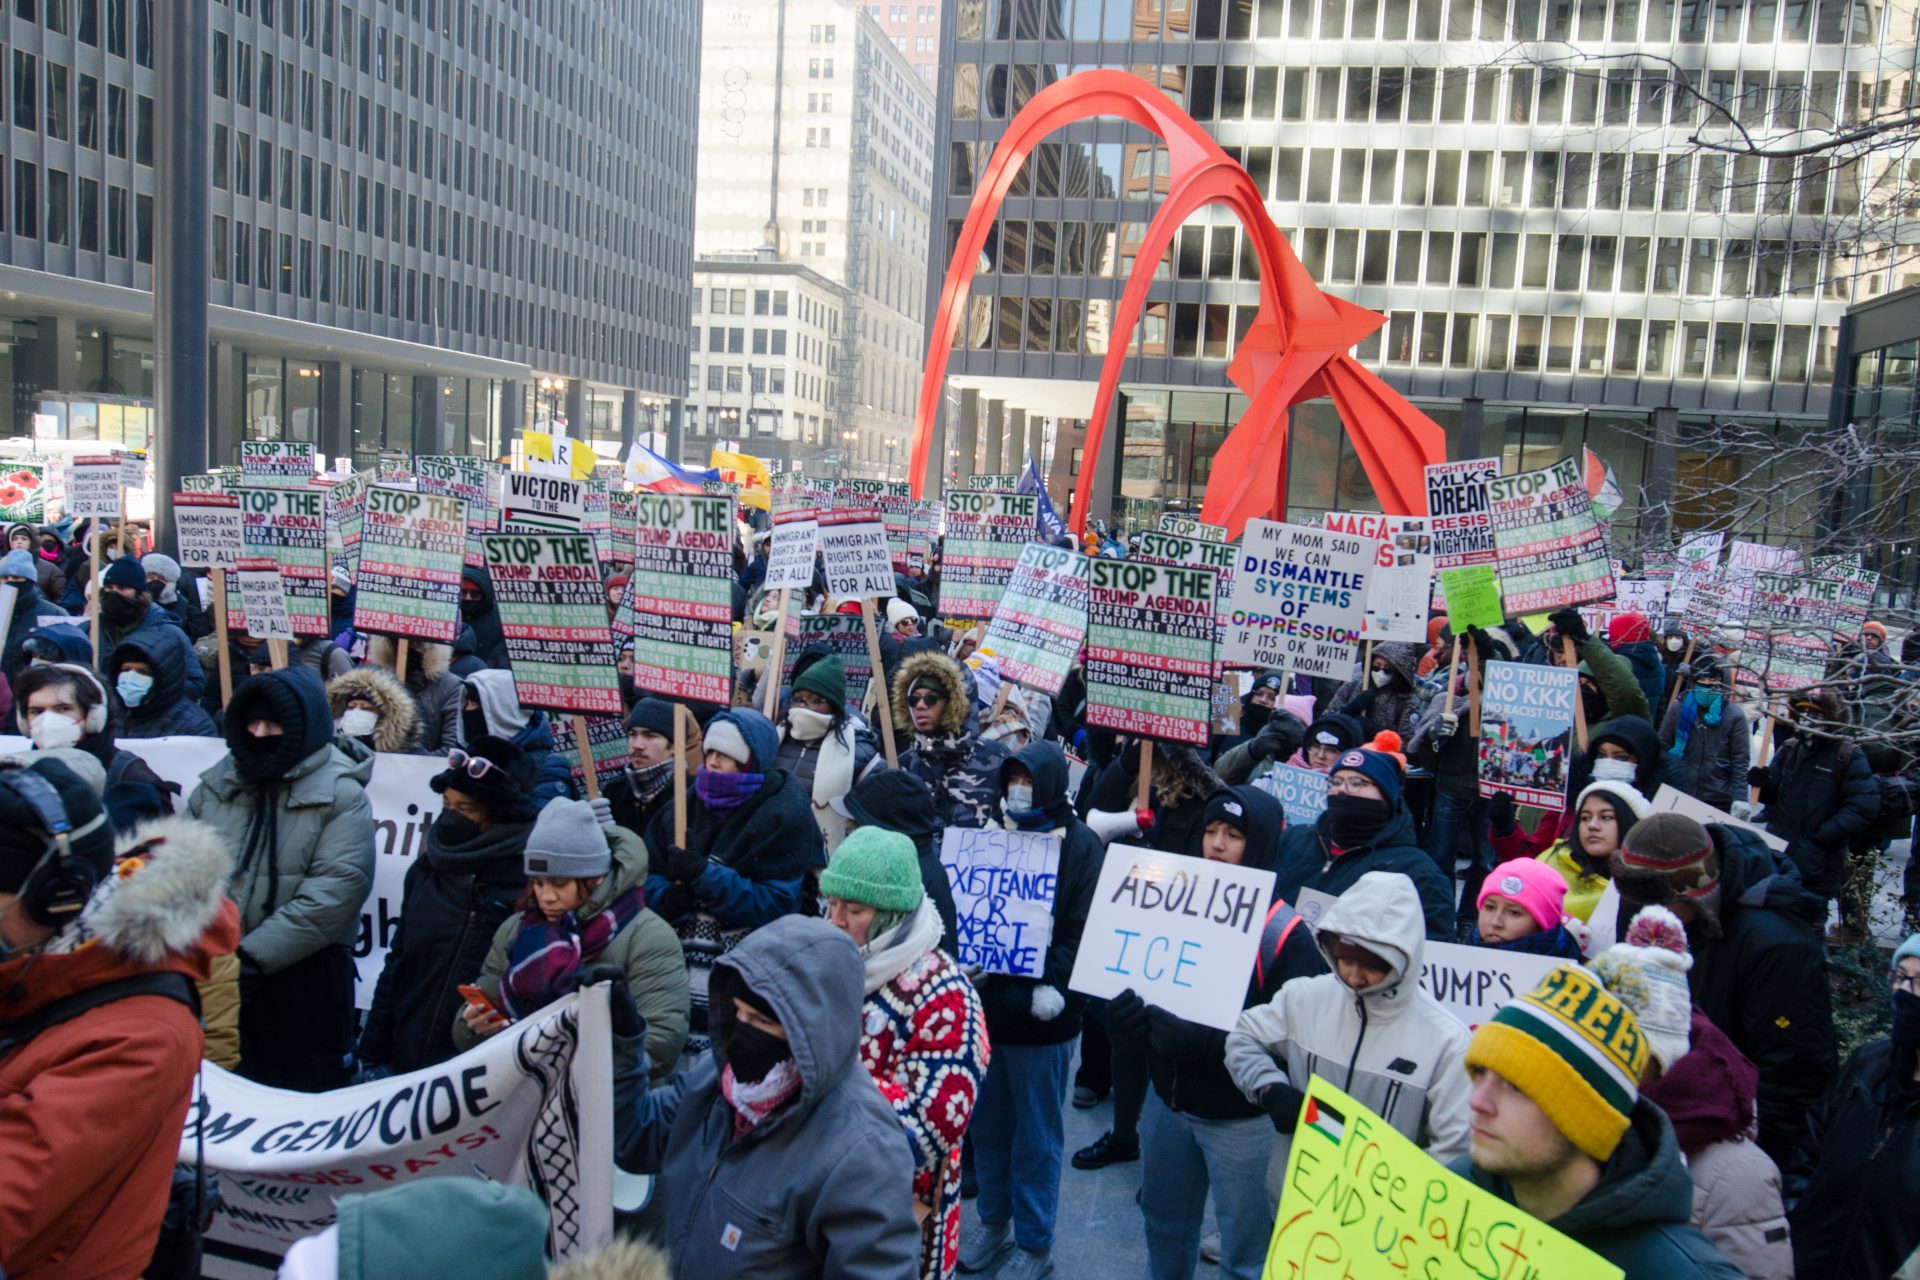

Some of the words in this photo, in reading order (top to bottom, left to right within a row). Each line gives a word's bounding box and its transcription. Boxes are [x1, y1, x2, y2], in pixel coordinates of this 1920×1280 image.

[244, 442, 280, 456] STOP
[285, 443, 310, 456] THE
[73, 472, 118, 481] IMMIGRANT
[421, 461, 455, 480] STOP
[460, 470, 484, 487] THE
[1427, 462, 1466, 476] FIGHT
[1470, 461, 1497, 471] FOR
[1427, 470, 1497, 488] MLK'S
[74, 483, 98, 491] RIGHTS
[102, 483, 118, 491] AND
[183, 476, 214, 490] STOP
[420, 476, 446, 486] TRUMP
[511, 474, 579, 504] VICTORY
[813, 480, 832, 492] THE
[853, 481, 884, 494] STOP
[888, 483, 909, 496] THE
[970, 477, 992, 488] STOP
[995, 477, 1015, 488] THE
[1490, 471, 1547, 501] STOP
[1552, 460, 1579, 488] THE
[74, 502, 92, 512] FOR
[96, 502, 118, 512] ALL!
[284, 493, 320, 515] THE
[368, 490, 420, 515] STOP
[427, 497, 464, 521] THE
[532, 499, 541, 509] TO
[544, 501, 559, 512] THE
[639, 497, 684, 529] STOP
[690, 500, 727, 532] THE
[950, 494, 995, 513] STOP
[1000, 496, 1034, 516] THE
[1490, 496, 1535, 514] TRUMP
[178, 514, 239, 526] IMMIGRANT
[270, 515, 321, 529] AGENDA!
[367, 511, 405, 527] TRUMP
[410, 518, 464, 536] AGENDA!
[947, 512, 981, 524] TRUMP
[986, 514, 1034, 528] AGENDA!
[1161, 517, 1196, 536] STOP
[1200, 525, 1225, 542] THE
[1326, 514, 1398, 541] MAGA-
[1432, 514, 1488, 530] RESIS
[181, 527, 216, 538] RIGHTS
[221, 528, 239, 538] AND
[637, 527, 671, 546] TRUMP
[676, 532, 729, 551] AGENDA!
[774, 529, 816, 541] IMMIGRANT
[823, 533, 882, 548] IMMIGRANT
[1261, 527, 1281, 542] MY
[1291, 533, 1323, 549] MOM
[1331, 540, 1360, 555] SAID
[1433, 527, 1490, 538] TRUMP
[181, 540, 240, 549] LEGALIZATION
[182, 550, 209, 562] FOR
[485, 537, 541, 565] STOP
[547, 538, 593, 564] THE
[772, 545, 796, 556] RIGHTS
[800, 543, 814, 554] AND
[828, 551, 862, 563] RIGHTS
[868, 549, 886, 560] AND
[1142, 534, 1193, 560] STOP
[1200, 543, 1236, 568] THE
[1021, 546, 1069, 571] STOP
[1274, 547, 1294, 562] WE
[1304, 552, 1331, 567] CAN
[489, 565, 532, 579] TRUMP
[538, 566, 598, 581] AGENDA!
[768, 569, 784, 582] FOR
[790, 566, 810, 581] ALL!
[828, 563, 889, 576] LEGALIZATION
[1017, 565, 1049, 580] TRUMP
[1092, 561, 1157, 592] STOP
[1164, 569, 1211, 600] THE
[1243, 556, 1364, 592] DISMANTLE
[1835, 566, 1856, 577] STOP
[1858, 570, 1878, 583] THE
[831, 578, 858, 593] FOR
[865, 577, 892, 592] ALL!
[1253, 577, 1352, 609] SYSTEMS
[1808, 581, 1840, 600] THE
[1091, 587, 1139, 605] TRUMP
[1144, 596, 1211, 617] AGENDA!
[1280, 601, 1310, 619] OF
[1089, 613, 1159, 633] IMMIGRANT
[1166, 624, 1214, 640] RIGHTS
[1090, 603, 1138, 618] DEFEND
[1145, 610, 1153, 621] &
[1161, 611, 1215, 629] EXPAND
[1231, 610, 1360, 647] OPPRESSION
[1237, 631, 1250, 644] IF
[1257, 633, 1277, 649] ITS
[1286, 639, 1307, 654] OK
[1316, 644, 1348, 661] WITH
[1087, 649, 1117, 660] STOP
[1122, 652, 1162, 667] POLICE
[1167, 658, 1211, 674] CRIMES
[1251, 649, 1285, 666] YOUR
[1292, 656, 1330, 674] MOM!
[1087, 660, 1128, 675] DEFEND
[1131, 665, 1184, 682] LGBTQIA+
[1187, 674, 1211, 688] AND
[1087, 671, 1166, 692] REPRODUCTIVE
[1170, 684, 1210, 699] RIGHTS
[1489, 665, 1513, 681] NO
[1517, 668, 1575, 688] TRUMP
[1487, 681, 1518, 702] NO
[1523, 685, 1571, 710] KKK
[1087, 703, 1127, 718] DEFEND
[1131, 710, 1195, 728] EDUCATION
[1485, 702, 1501, 712] NO
[1503, 703, 1545, 719] RACIST
[1547, 709, 1570, 722] USA
[1087, 714, 1146, 732] ACADEMIC
[1151, 724, 1207, 745] FREEDOM
[1275, 767, 1294, 782] NO
[1272, 780, 1297, 802] NO
[1300, 789, 1328, 811] KK
[957, 830, 1053, 874] RESPECT
[972, 894, 1010, 927] OR
[1110, 863, 1261, 935] ABOLISH
[957, 912, 1030, 951] XPECT
[958, 943, 1038, 974] ISTANCE
[1104, 928, 1202, 989] ICE
[251, 1065, 502, 1153] GENOCIDE
[368, 1124, 502, 1181] PAYS!
[1343, 1115, 1407, 1214] Free
[1292, 1149, 1366, 1226] END
[1373, 1215, 1417, 1278] U.S.
